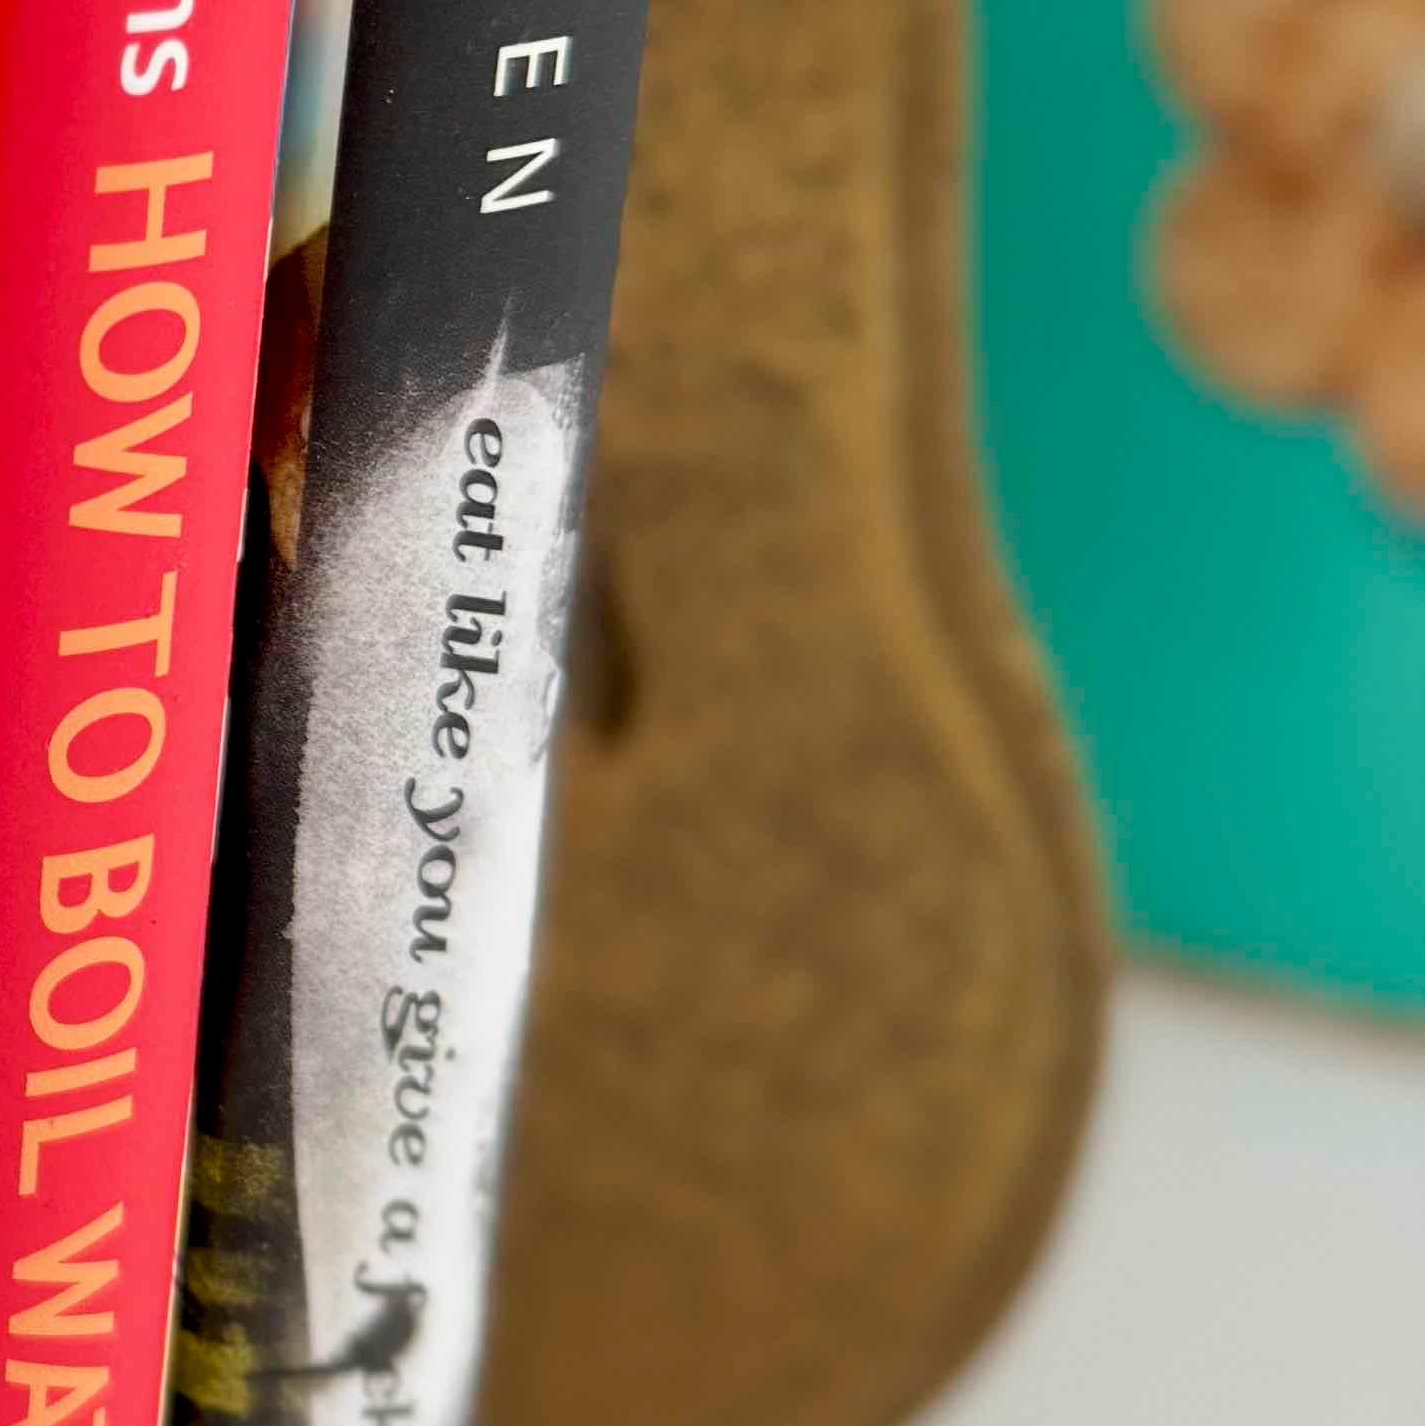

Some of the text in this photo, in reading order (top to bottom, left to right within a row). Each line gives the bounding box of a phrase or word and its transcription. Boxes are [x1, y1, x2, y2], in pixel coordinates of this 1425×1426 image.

[67, 148, 217, 541] HOW
[451, 416, 507, 565] eat
[45, 569, 178, 806] TO
[432, 587, 510, 763] like
[405, 773, 473, 965] you
[16, 831, 158, 1198] BOIL
[375, 982, 455, 1168] give
[379, 1197, 423, 1255] a
